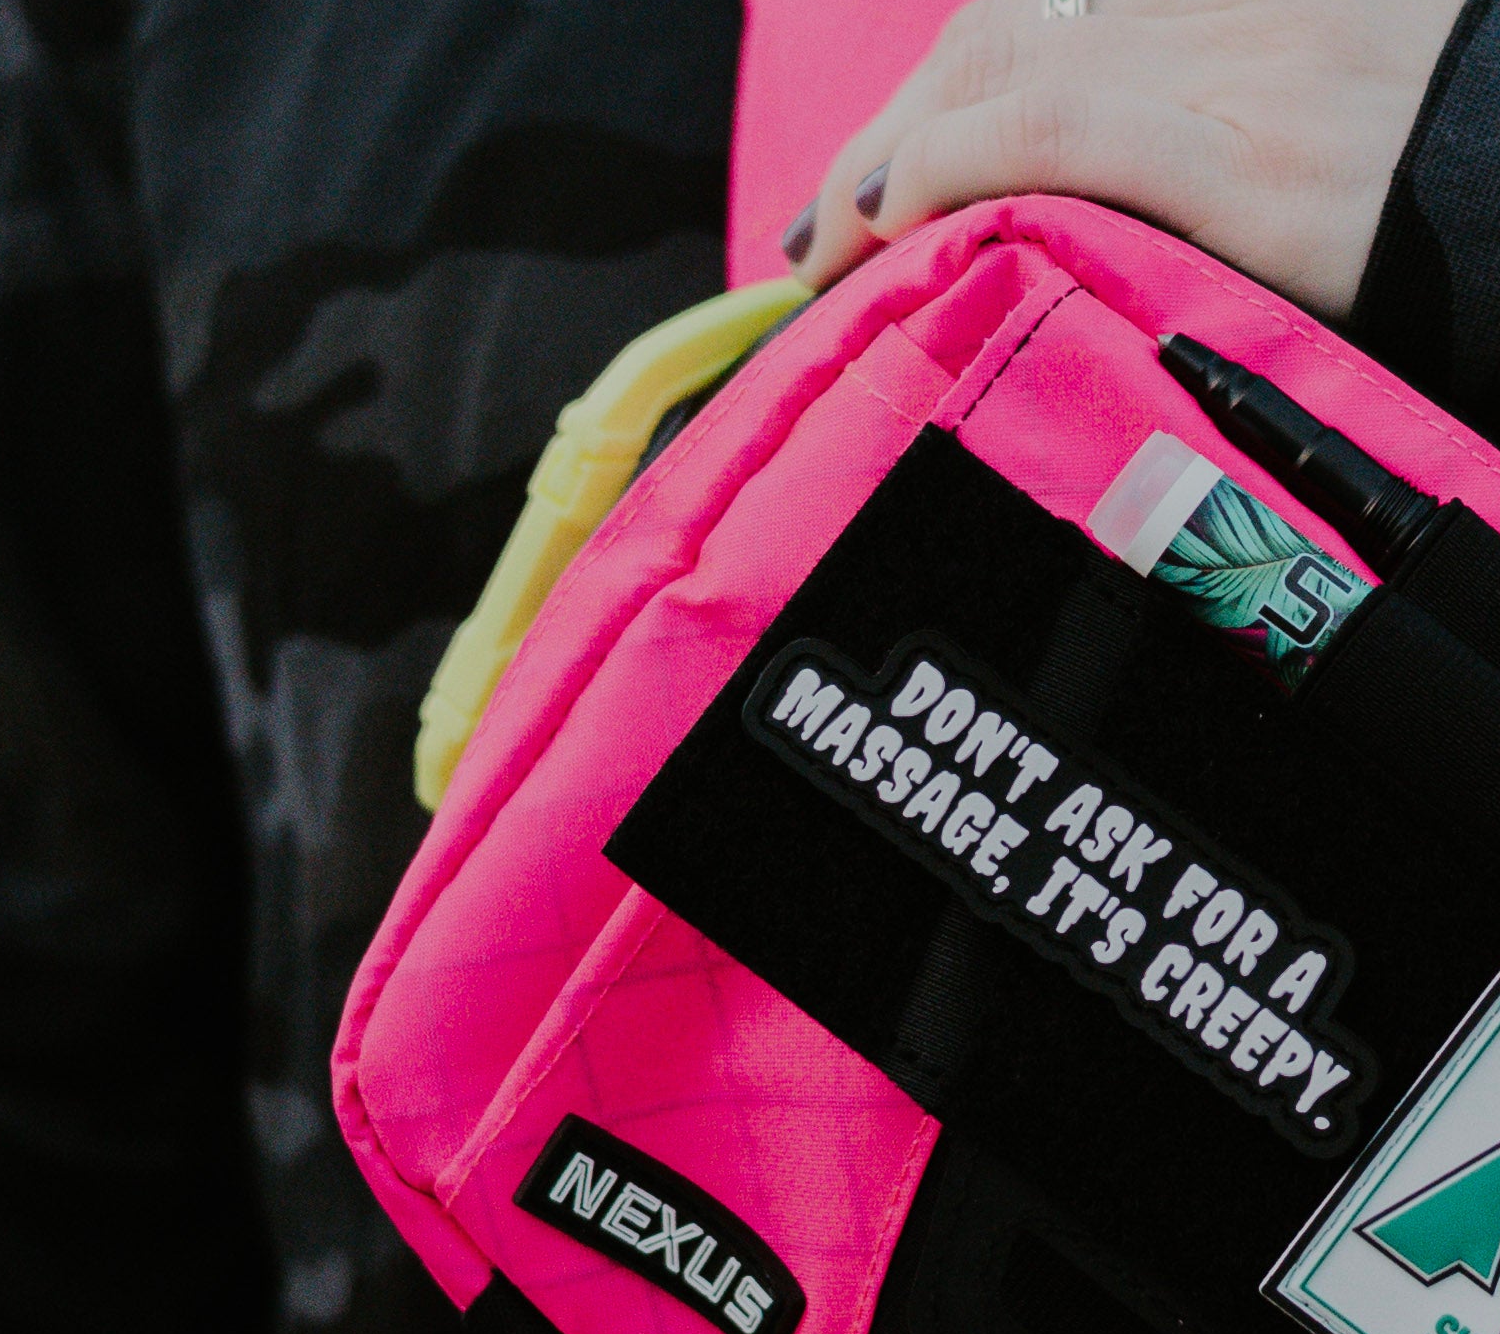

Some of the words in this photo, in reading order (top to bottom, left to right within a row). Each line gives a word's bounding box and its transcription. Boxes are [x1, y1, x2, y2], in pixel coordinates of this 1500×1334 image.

[772, 667, 1030, 894] MASSAGE,
[1025, 855, 1147, 964] IT'S
[1140, 943, 1351, 1130] CREEPY.
[890, 660, 1060, 804] DON'T
[1044, 783, 1173, 893] ASK
[1162, 863, 1279, 977] FOR
[1267, 950, 1327, 1014] A
[549, 1152, 774, 1334] NEXUS
